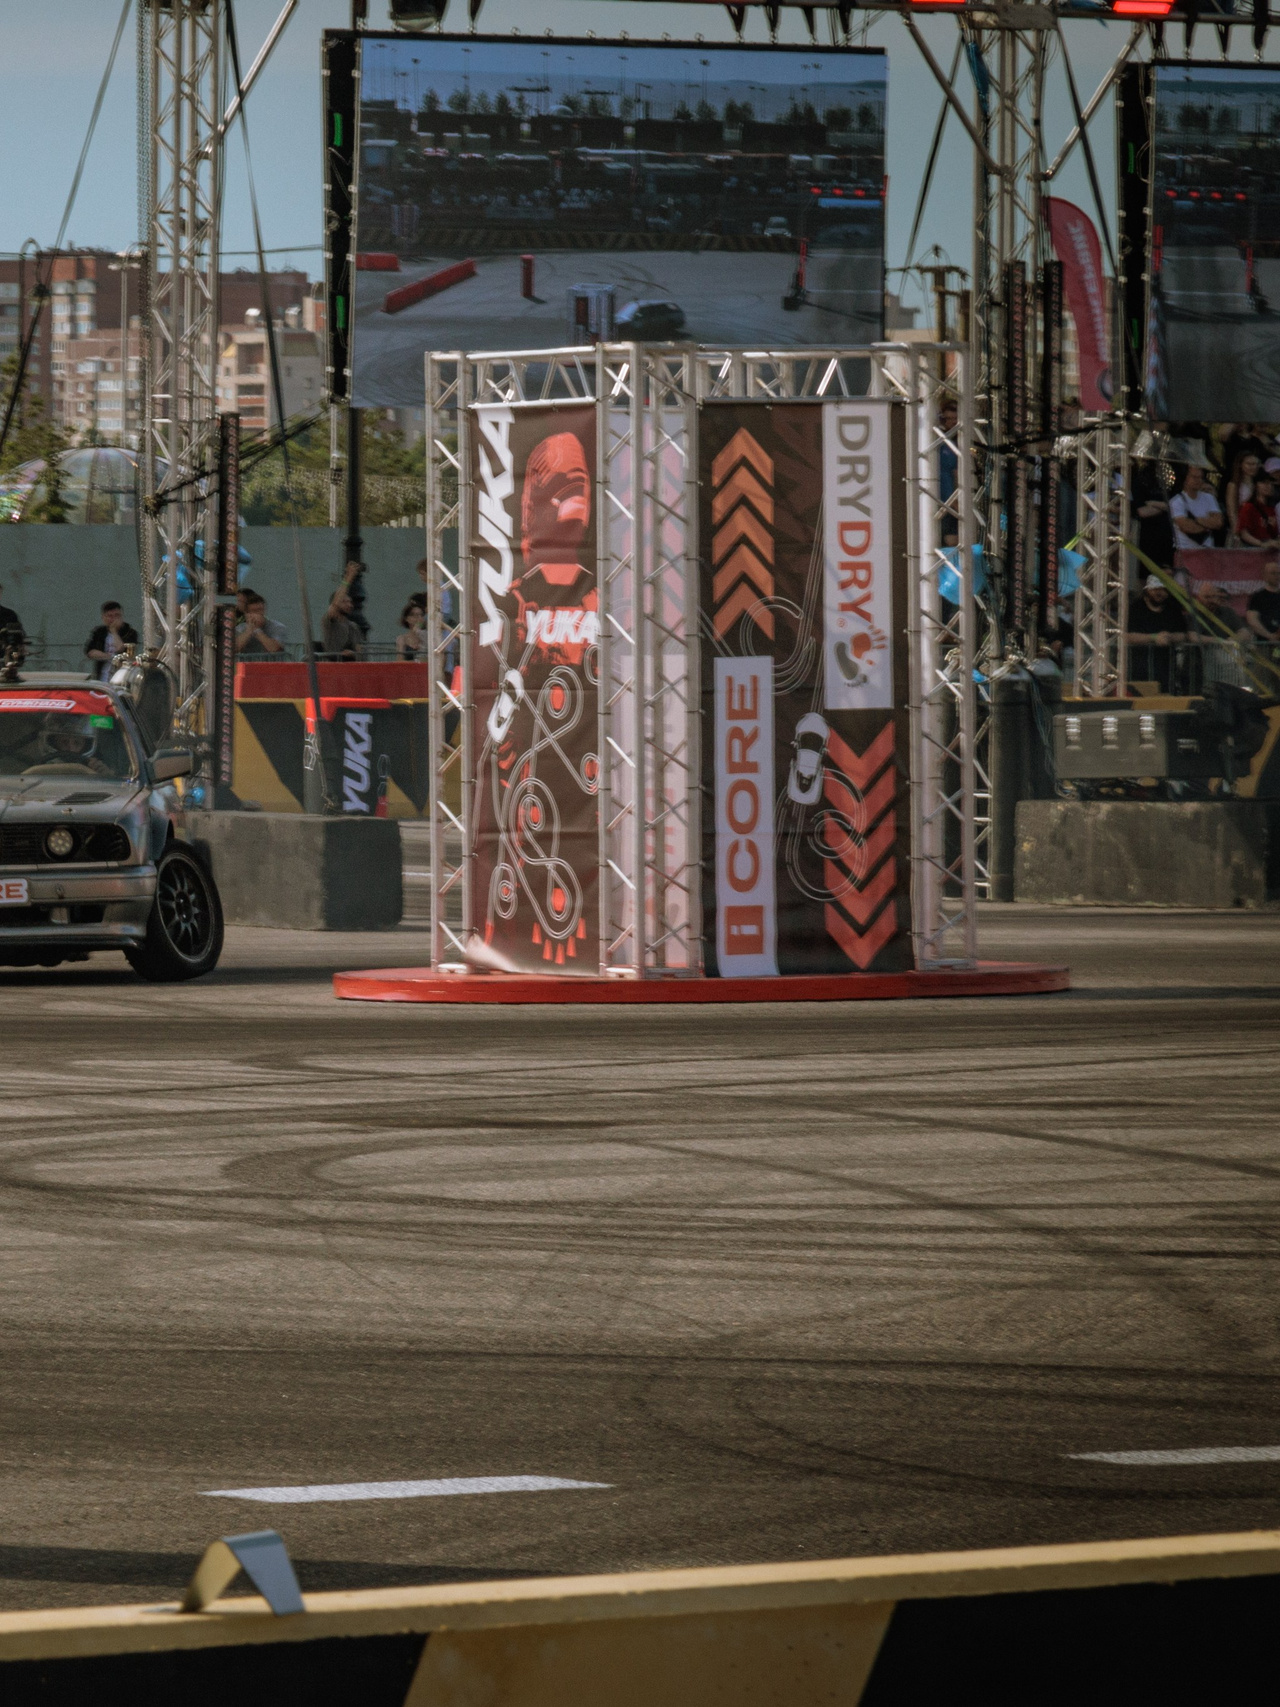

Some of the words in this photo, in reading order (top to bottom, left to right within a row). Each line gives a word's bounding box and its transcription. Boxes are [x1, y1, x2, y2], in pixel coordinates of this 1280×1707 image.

[477, 407, 516, 647] YUKA
[525, 609, 600, 644] YUKA
[342, 712, 374, 813] YUKA
